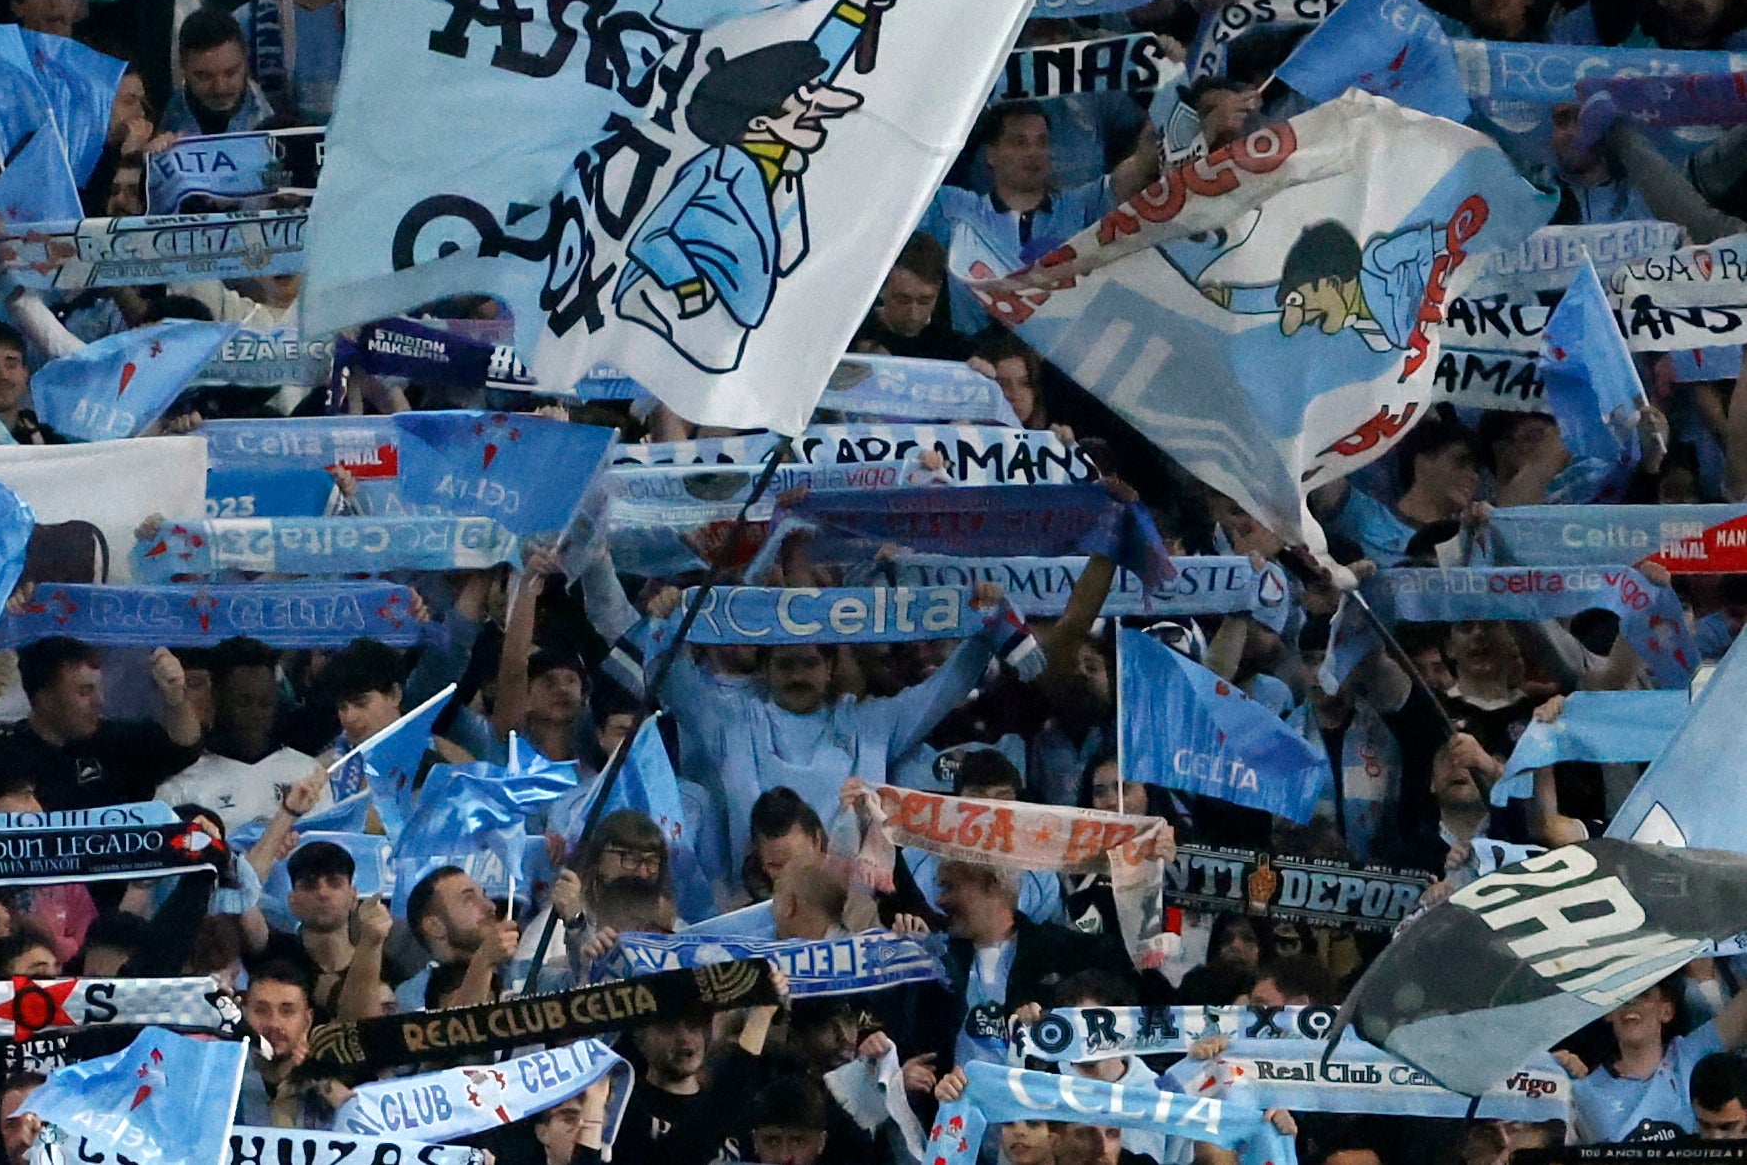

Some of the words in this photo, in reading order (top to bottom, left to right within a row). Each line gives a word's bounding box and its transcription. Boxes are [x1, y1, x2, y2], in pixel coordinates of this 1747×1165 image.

[374, 328, 446, 353] STADION
[1660, 540, 1708, 561] FINAL
[775, 586, 960, 637] Celta
[1172, 749, 1260, 793] CELTA
[55, 830, 165, 858] LEGADO
[403, 1007, 487, 1052] REAL
[488, 998, 568, 1038] CLUB
[570, 986, 658, 1024] CELTA
[380, 1085, 453, 1128] CLUB
[518, 1041, 610, 1092] CELTA
[1257, 1060, 1314, 1083] Real
[1322, 1062, 1382, 1086] Club
[1005, 1066, 1222, 1134] CELTA
